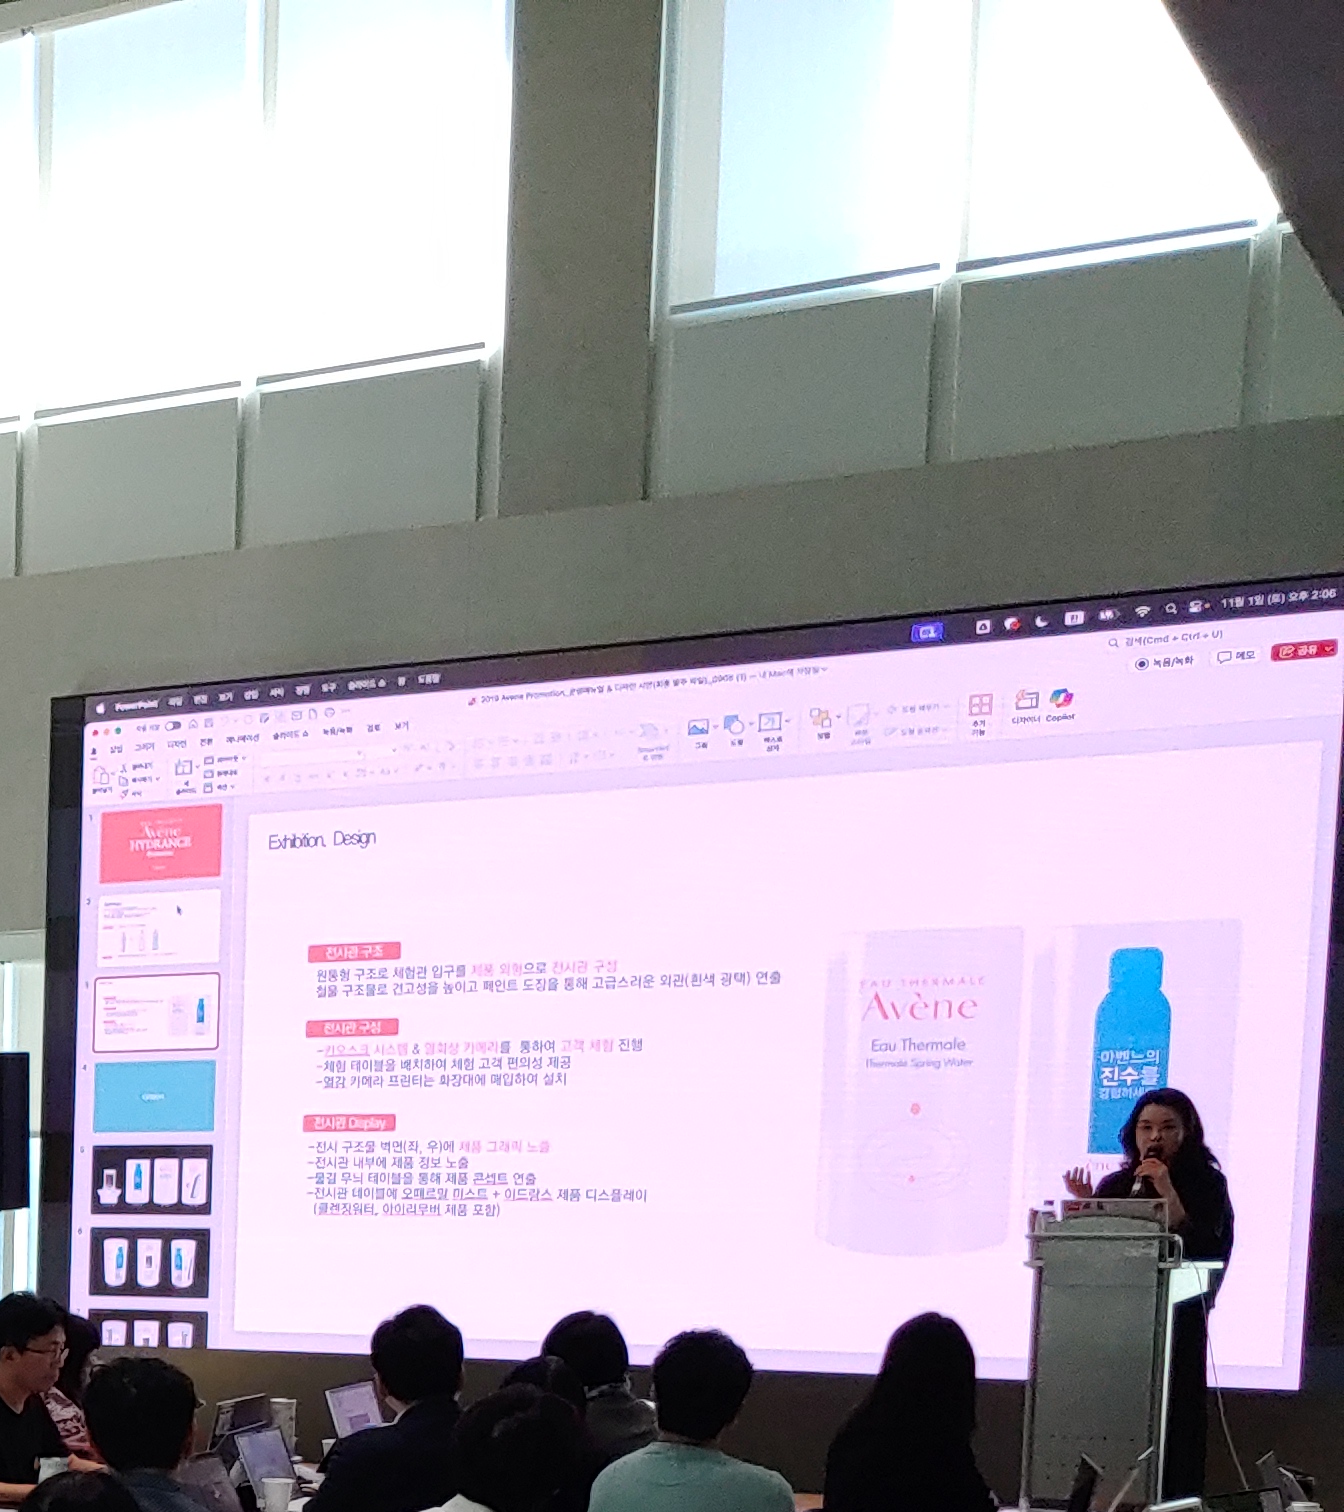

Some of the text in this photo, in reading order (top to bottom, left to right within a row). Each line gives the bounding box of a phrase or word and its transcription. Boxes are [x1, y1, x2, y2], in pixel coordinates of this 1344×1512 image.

[333, 830, 376, 848] Design
[354, 968, 388, 981] 구조로
[483, 979, 518, 992] 페인트
[592, 974, 654, 990] 고급스러운
[861, 991, 978, 1021] Avène
[413, 1044, 420, 1055] &
[872, 1037, 966, 1052] Eau Thermale
[479, 1057, 503, 1070] 고객
[1101, 1049, 1160, 1065] 아벤느의
[1100, 1065, 1160, 1087] 진수를
[391, 1156, 414, 1169] 제품
[445, 1173, 468, 1185] 제품
[557, 1188, 580, 1201] 제품
[586, 1188, 647, 1202] 디스플레이
[445, 1203, 467, 1216] 제품
